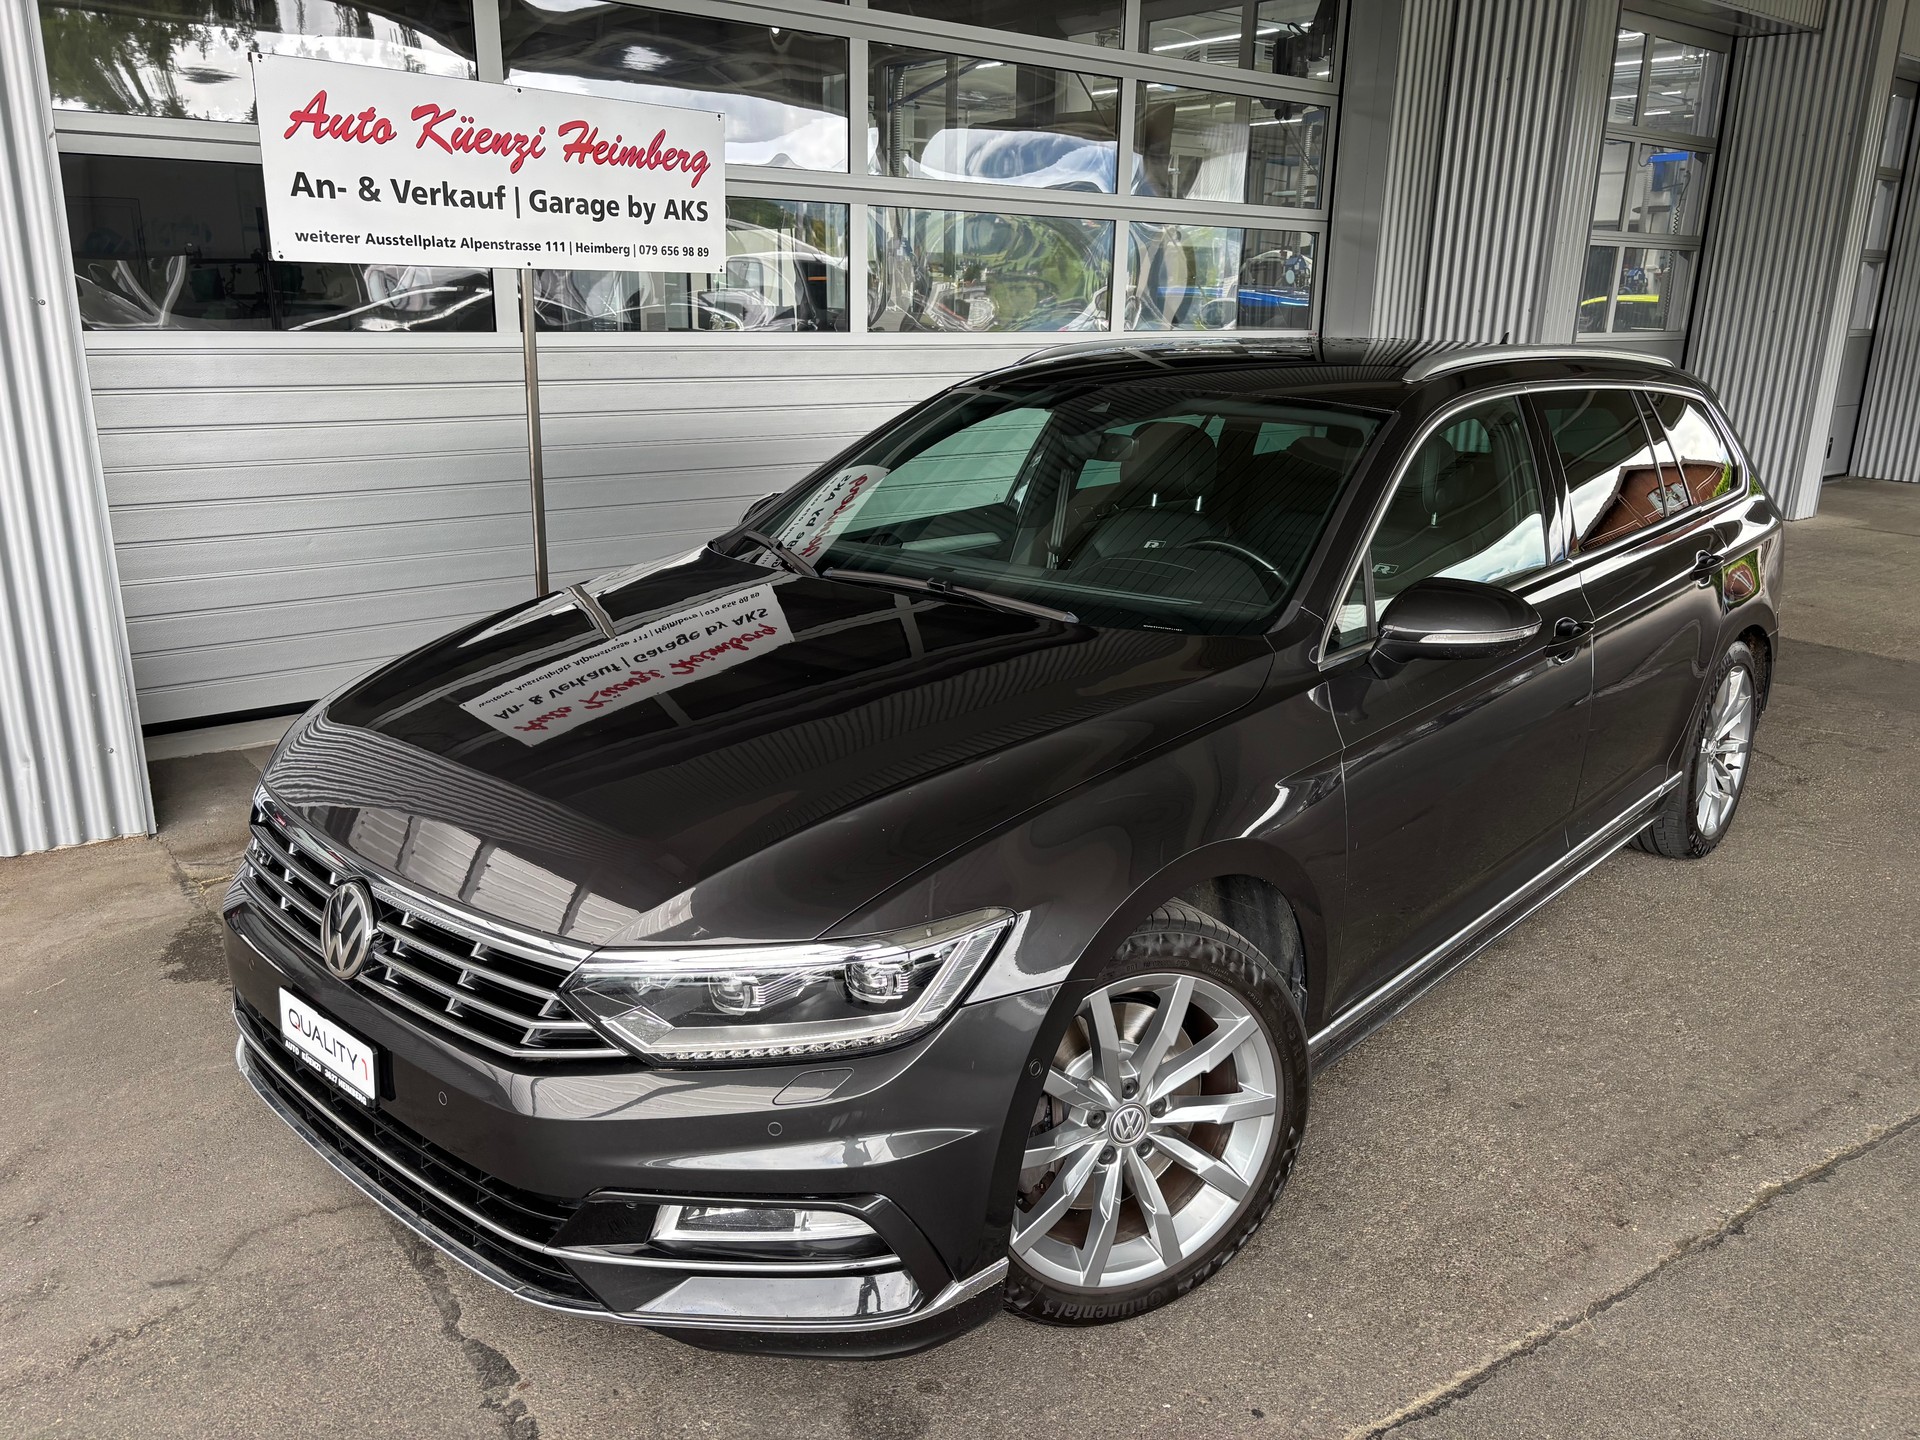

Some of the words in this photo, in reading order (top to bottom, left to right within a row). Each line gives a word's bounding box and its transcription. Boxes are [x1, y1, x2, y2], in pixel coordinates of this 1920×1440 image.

[284, 90, 397, 144] Auto
[411, 104, 546, 174] Küenzi
[558, 120, 711, 188] Heimberg
[291, 172, 346, 199] An-
[359, 176, 381, 202] &
[390, 179, 506, 209] Verkauf
[529, 190, 619, 222] Garage
[628, 195, 656, 224] by
[664, 199, 708, 221] AKS
[295, 230, 360, 244] weiterer
[366, 233, 456, 250] Ausstellplatz
[461, 237, 541, 252] Alpenstrasse
[546, 241, 564, 252] 111
[576, 242, 630, 257] Heimberg
[639, 245, 657, 255] 079
[661, 246, 679, 256] 656
[683, 247, 694, 256] 98
[698, 247, 709, 257] 89
